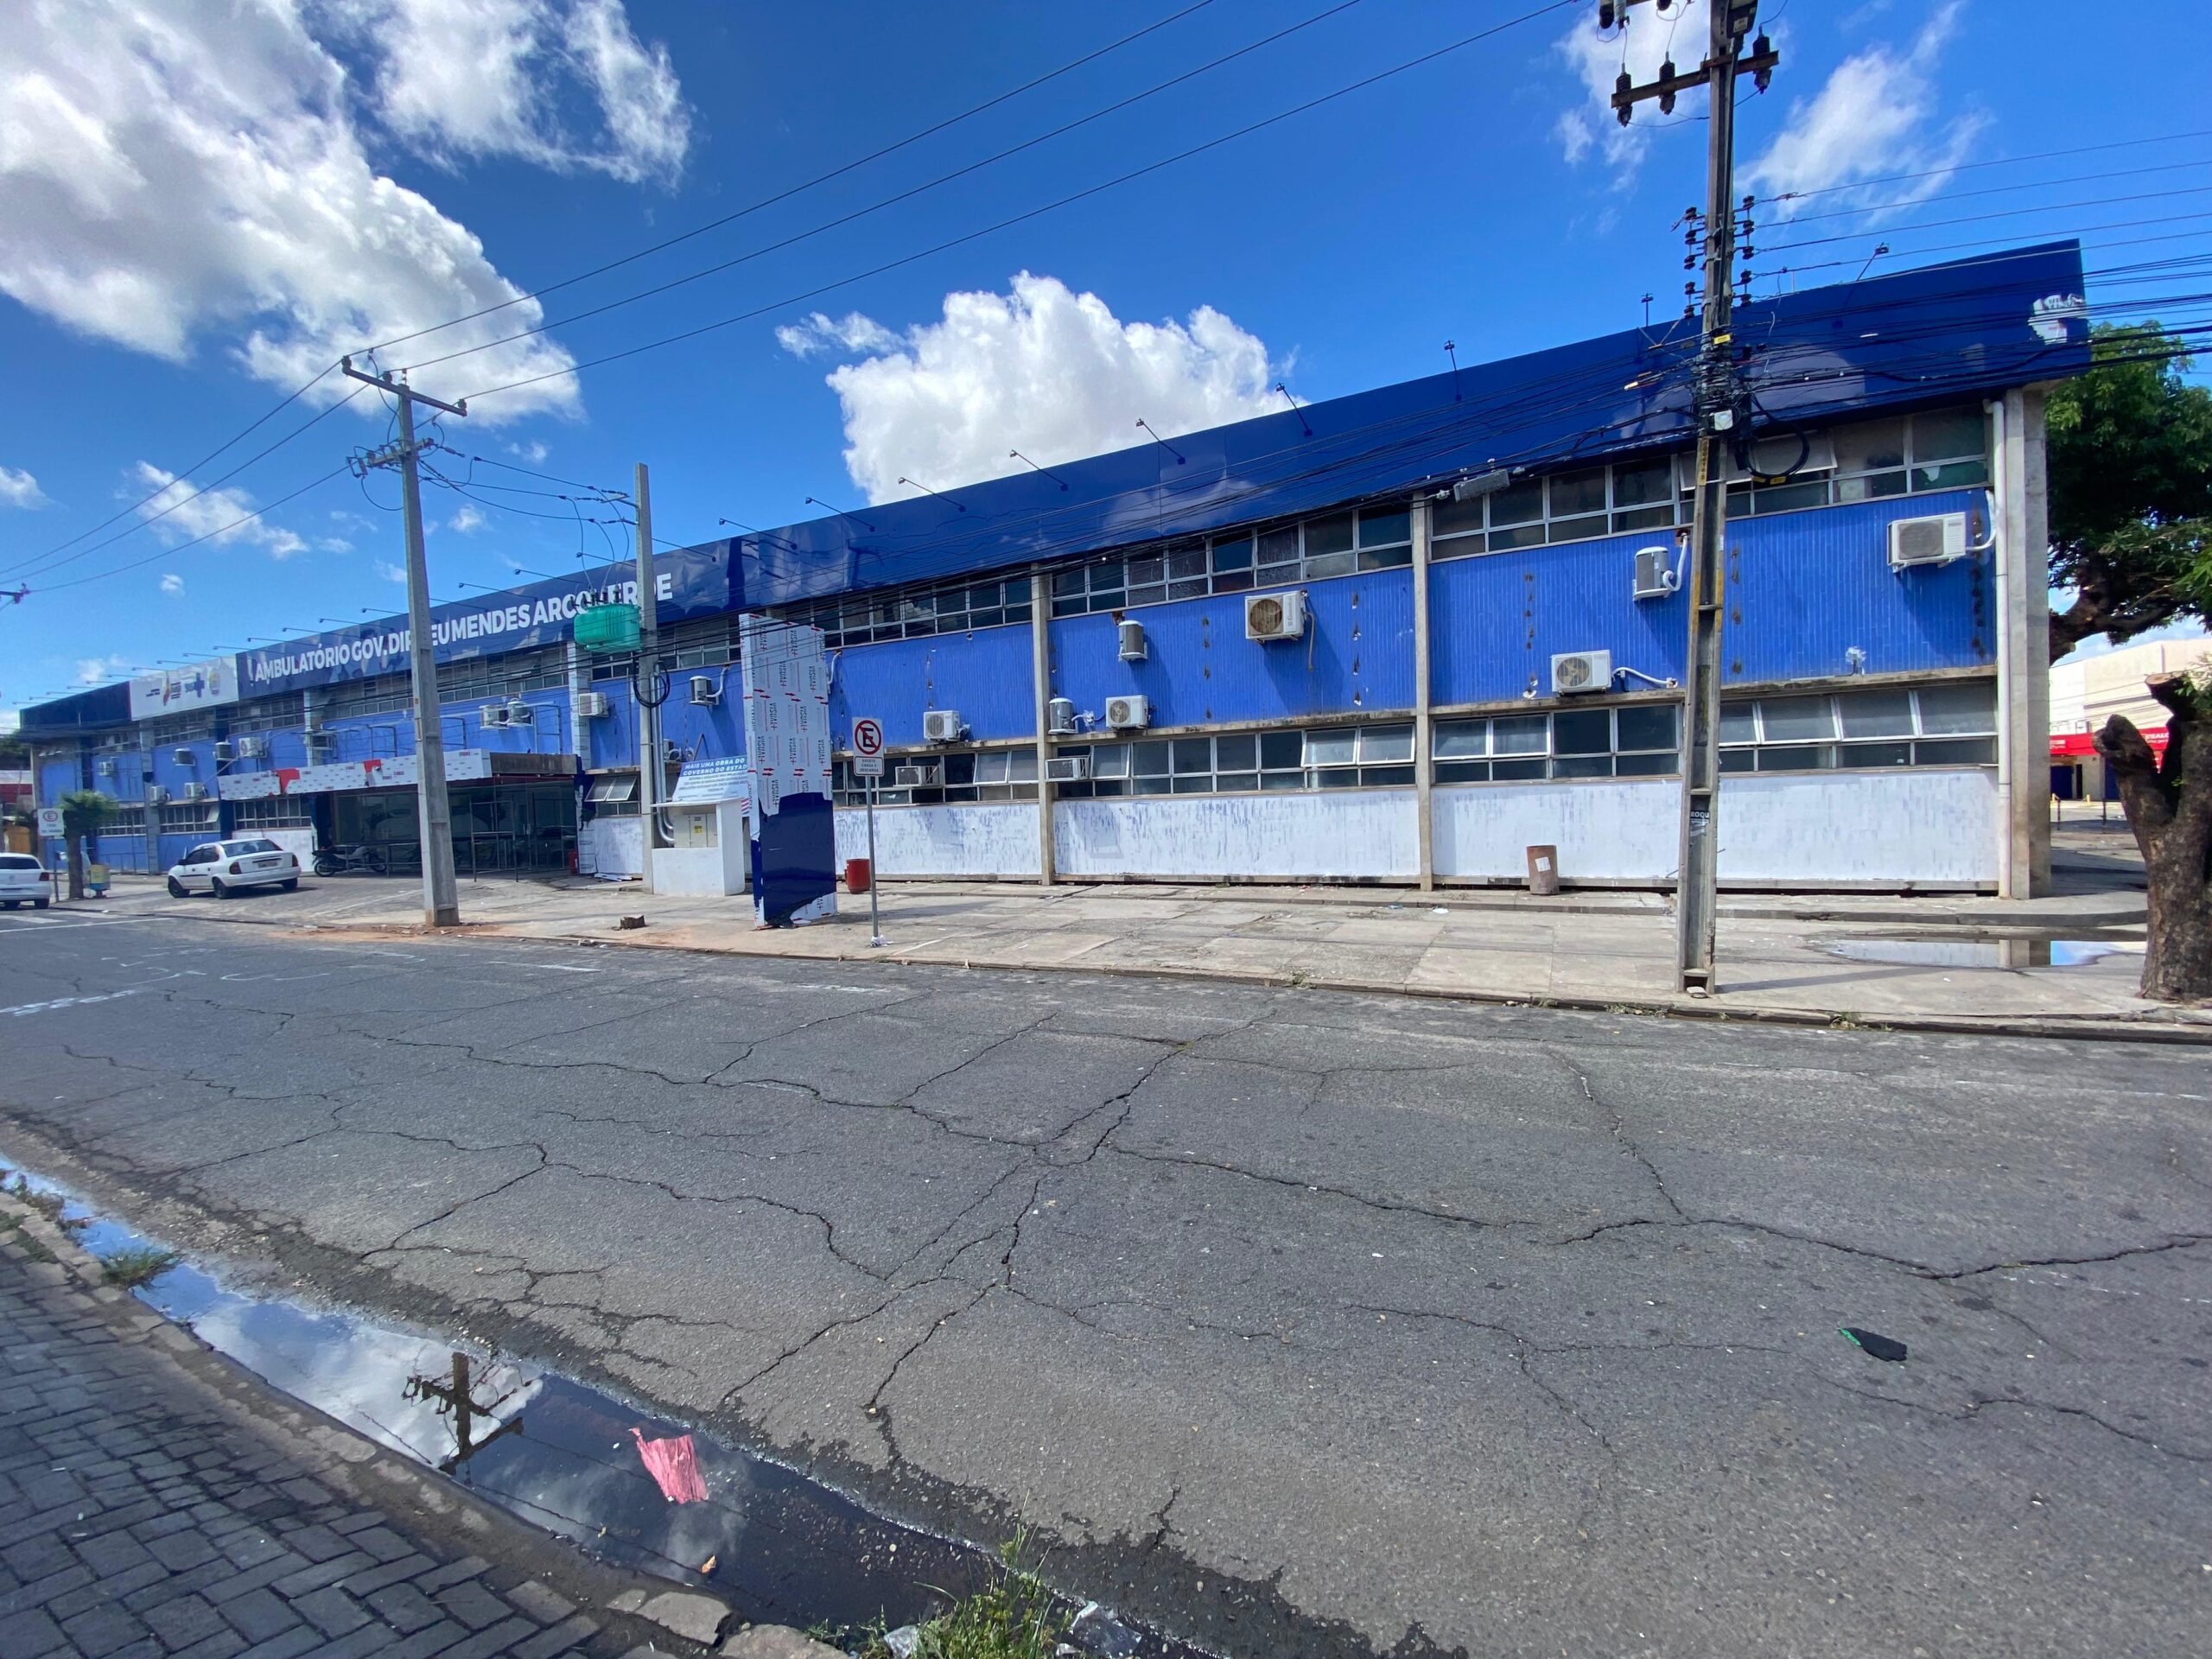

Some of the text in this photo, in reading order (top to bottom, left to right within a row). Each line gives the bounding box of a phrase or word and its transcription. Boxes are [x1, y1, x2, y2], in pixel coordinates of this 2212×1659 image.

[255, 643, 350, 683] AMBULATÓRIO
[352, 635, 387, 662] GOV.
[451, 603, 531, 642] MENDES
[532, 572, 673, 626] ARCOERE
